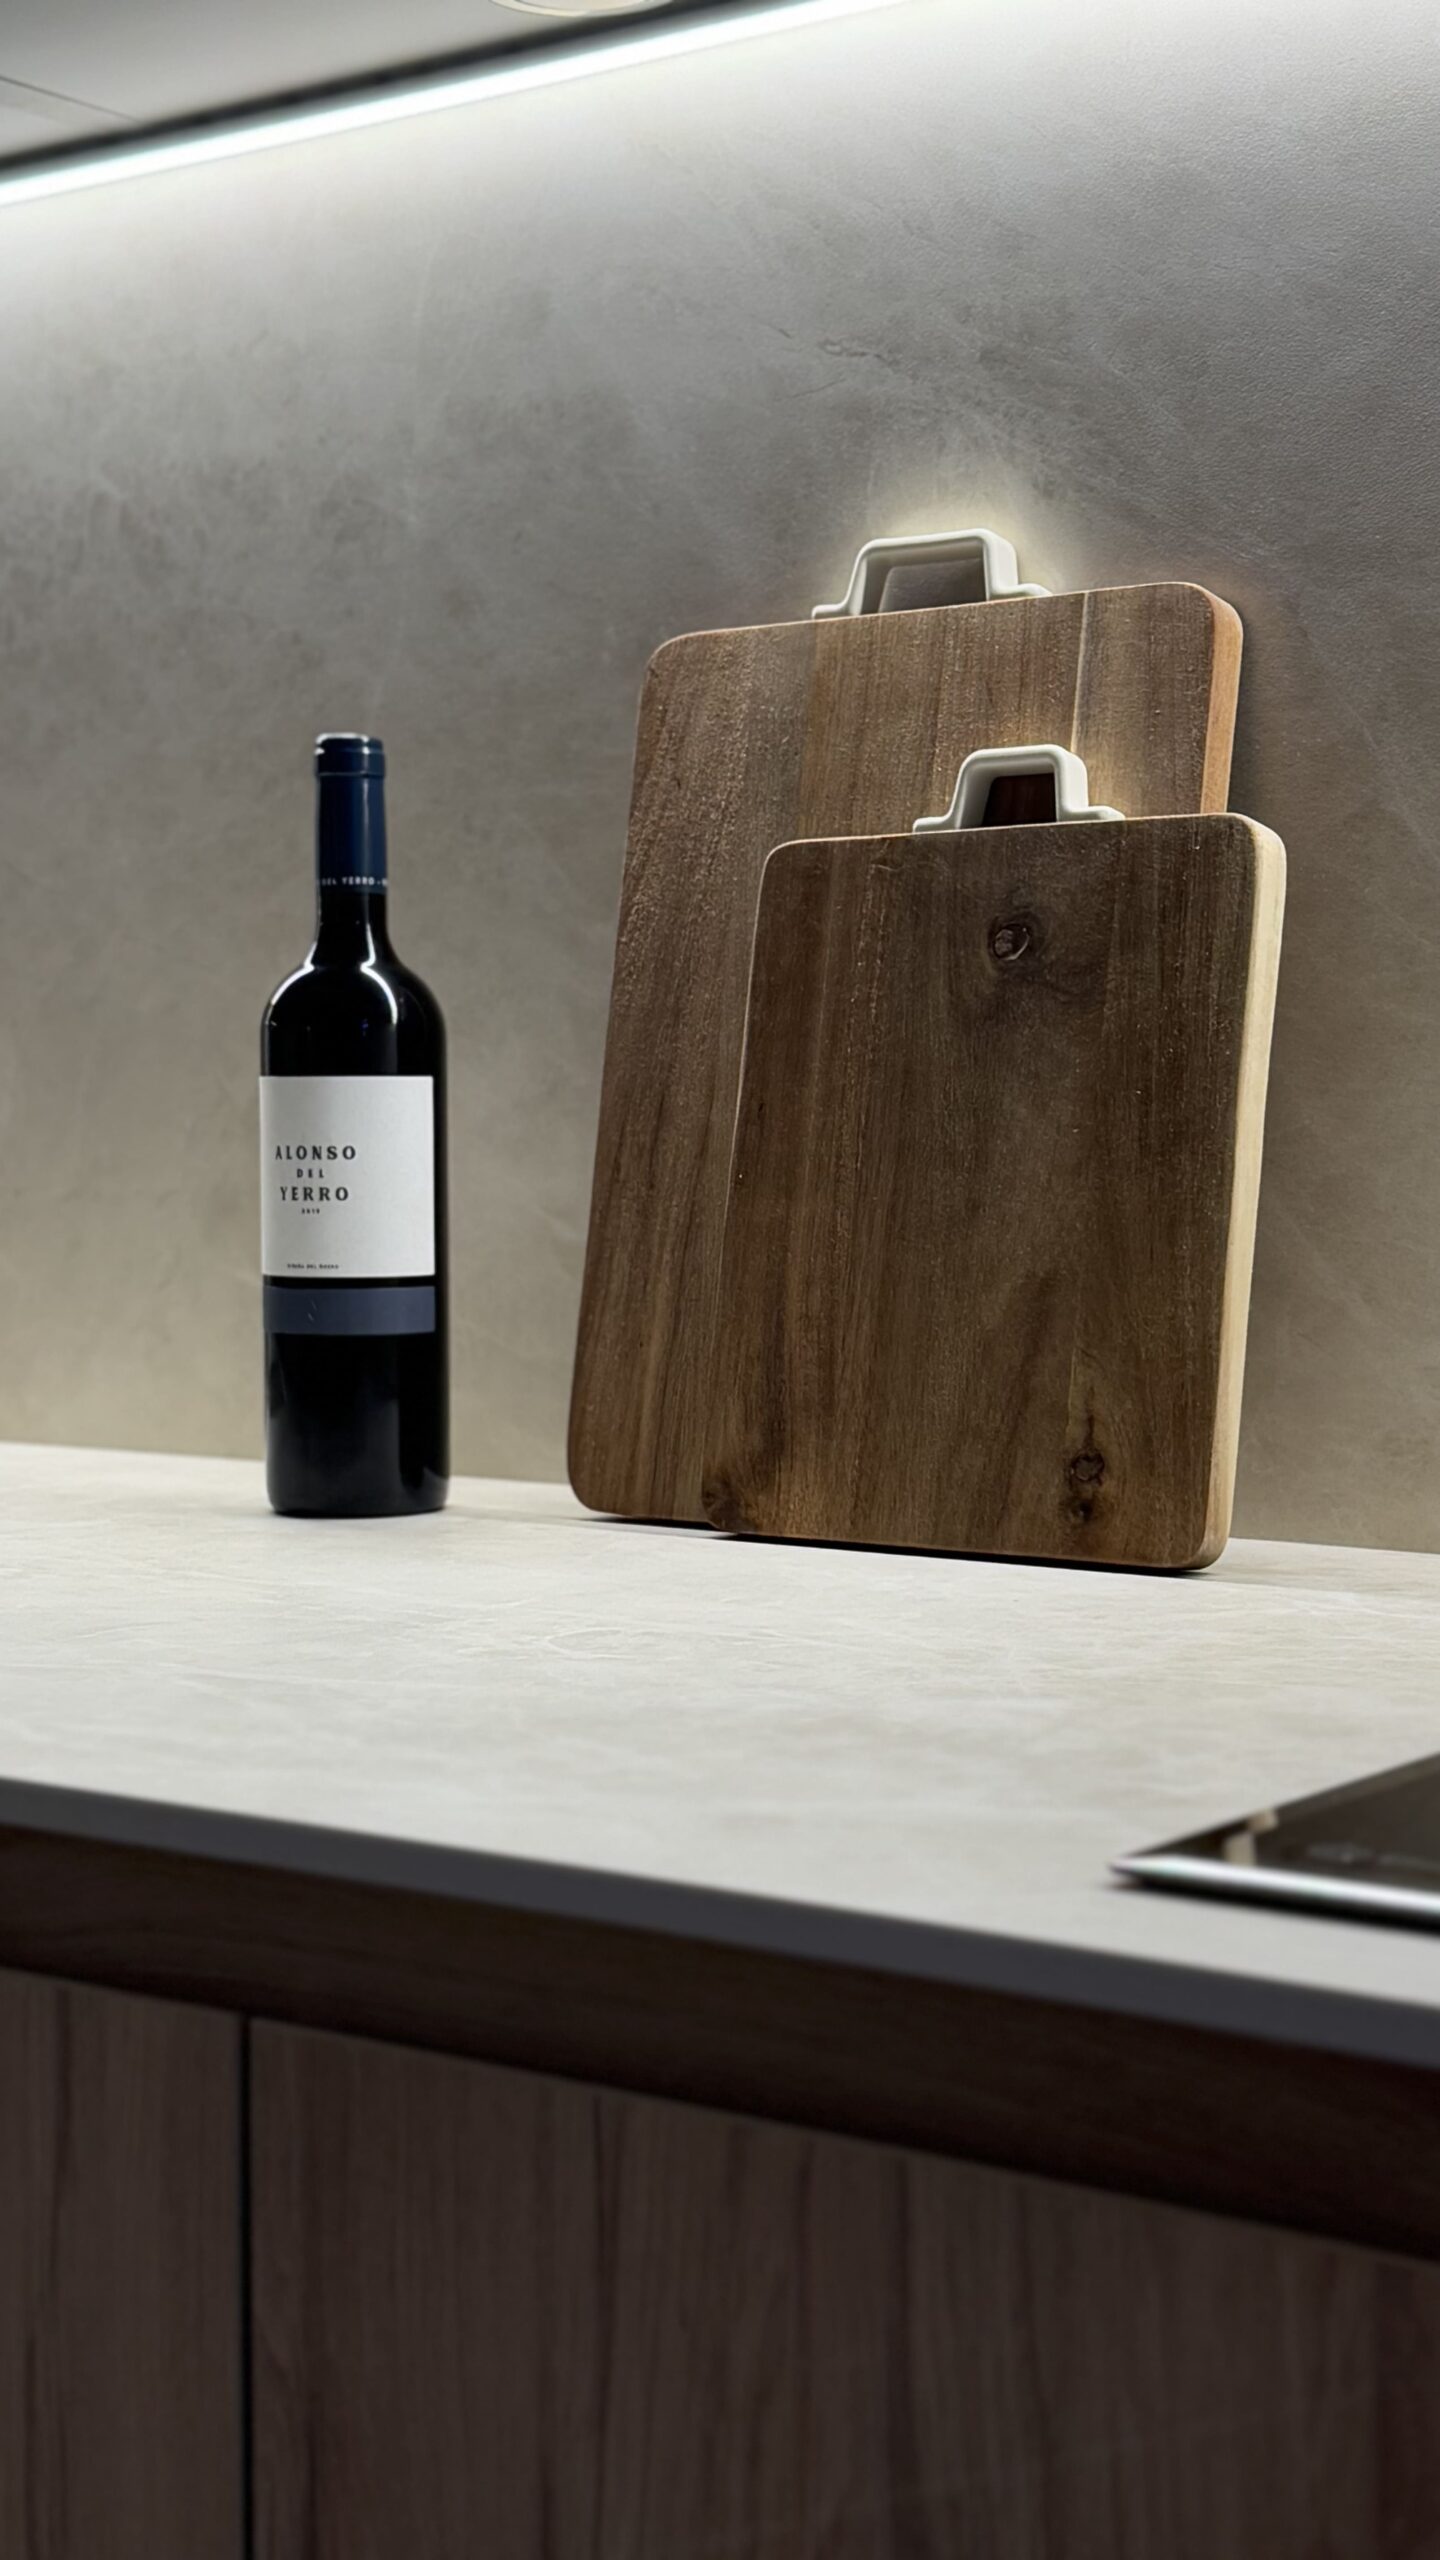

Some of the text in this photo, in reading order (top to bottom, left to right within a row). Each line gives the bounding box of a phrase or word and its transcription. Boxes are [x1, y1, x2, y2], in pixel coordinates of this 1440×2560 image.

[275, 1145, 356, 1160] ALONSO
[296, 1168, 324, 1178] DEL
[280, 1186, 349, 1201] YERRO
